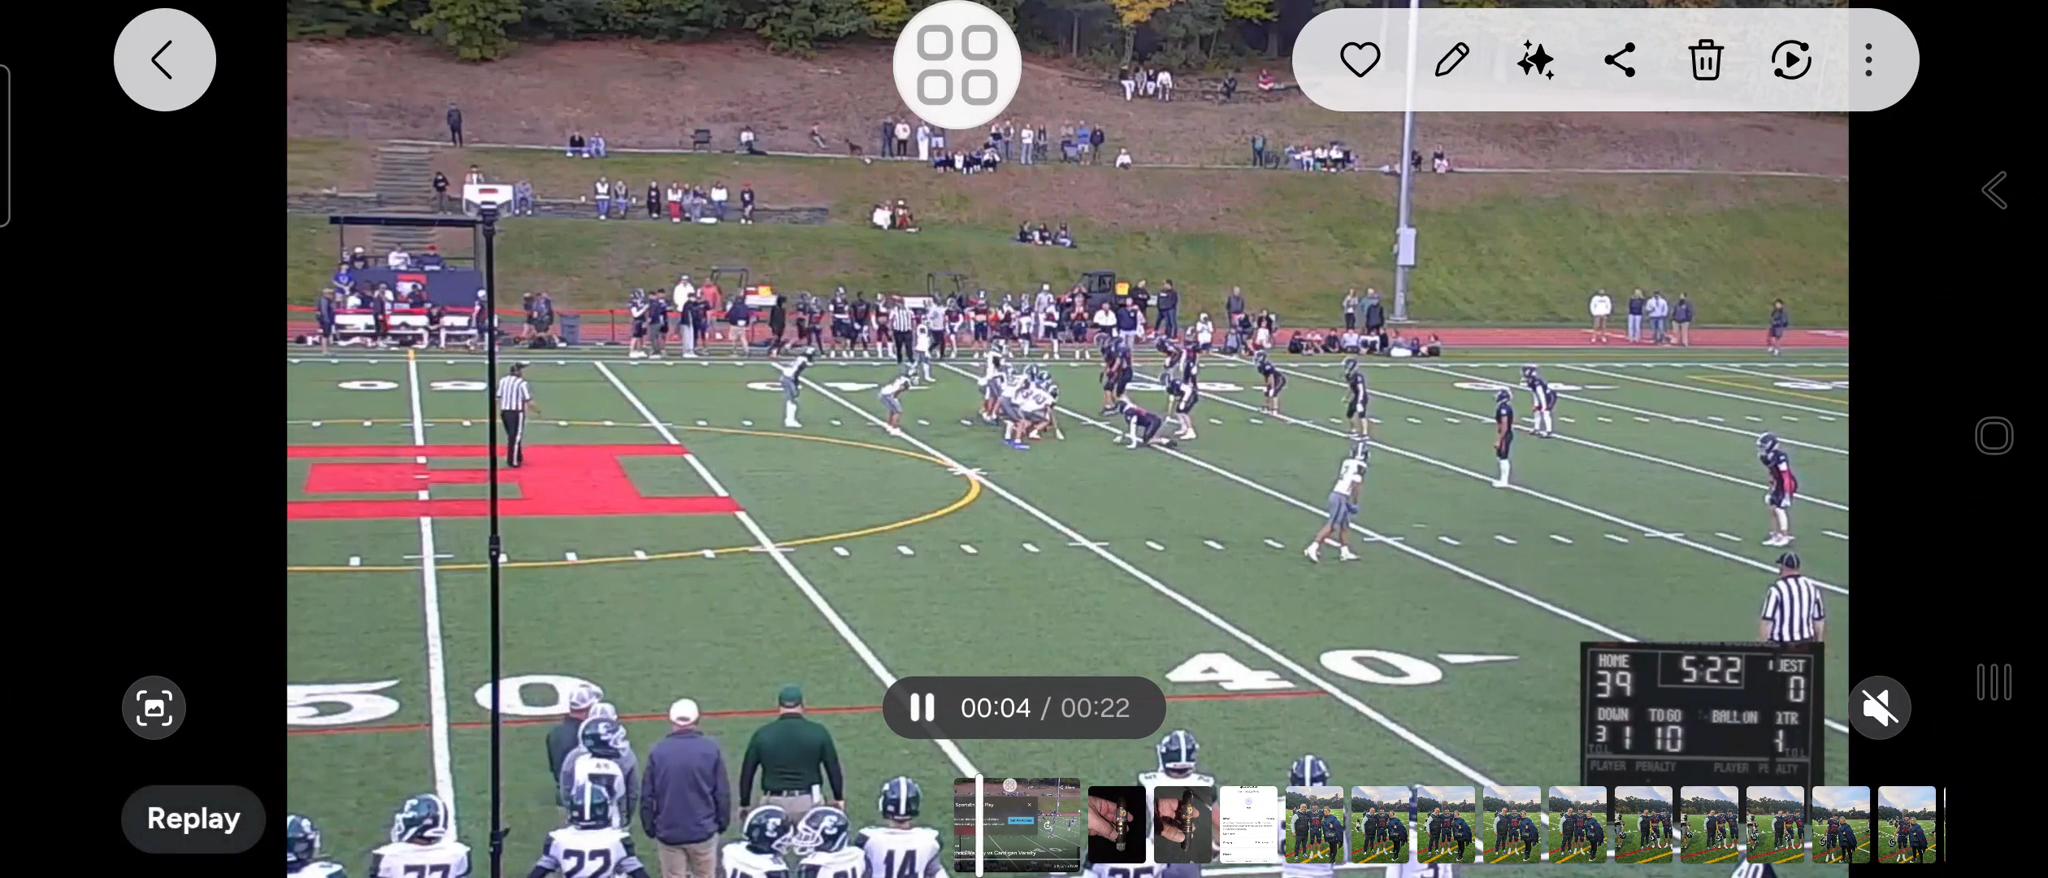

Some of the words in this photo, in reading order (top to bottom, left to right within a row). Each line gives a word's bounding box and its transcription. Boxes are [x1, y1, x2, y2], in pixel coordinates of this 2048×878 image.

[1598, 654, 1630, 668] HOME
[1681, 655, 1741, 684] 5:22
[1596, 670, 1631, 698] 39
[1789, 675, 1805, 703] 0
[1597, 707, 1630, 721] DOWN
[1648, 708, 1665, 722] TO
[1667, 709, 1682, 722] GO
[1712, 710, 1741, 724] BALL
[1742, 711, 1759, 724] ON
[1596, 725, 1607, 742] 3
[1625, 726, 1632, 750] 1
[1656, 725, 1682, 752] 10
[1590, 760, 1626, 771] PLAYER
[1635, 760, 1677, 772] PENALTY
[1713, 762, 1749, 773] PLAYER
[1758, 763, 1799, 774] PEALTY
[883, 849, 918, 878] 14
